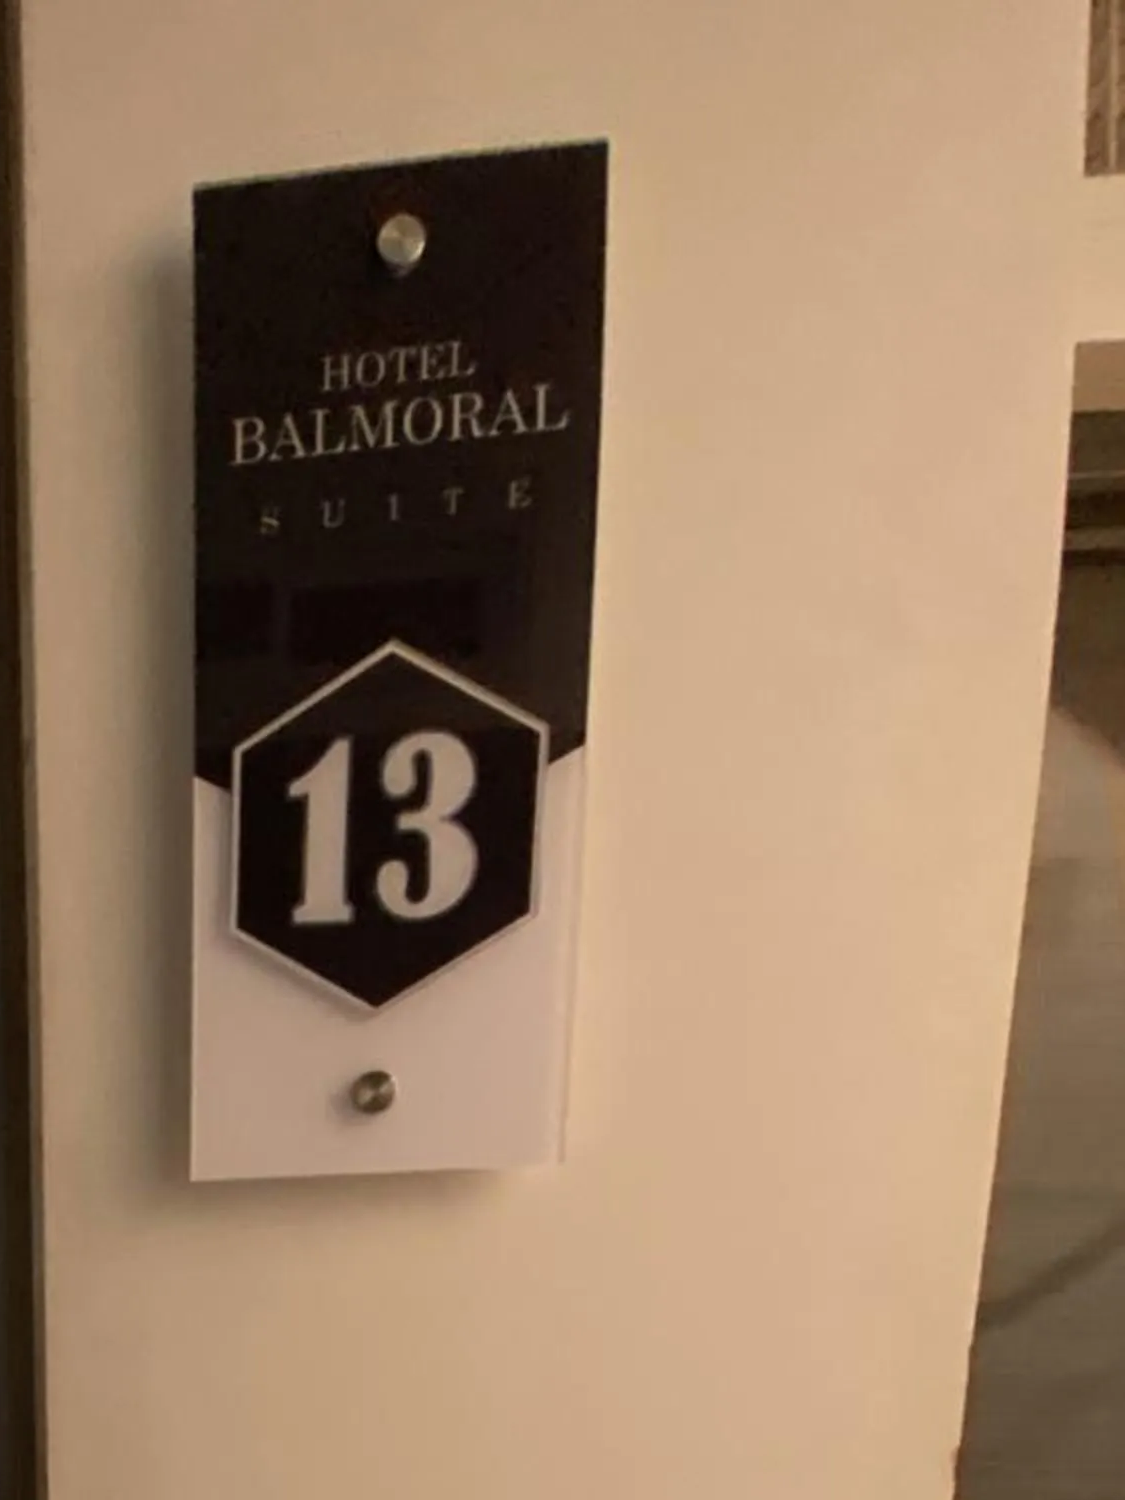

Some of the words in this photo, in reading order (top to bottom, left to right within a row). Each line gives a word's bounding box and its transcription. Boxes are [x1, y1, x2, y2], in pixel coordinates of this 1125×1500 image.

[321, 340, 477, 391] HOTEL
[229, 383, 571, 465] BALMORAL
[260, 476, 534, 535] SUITE
[287, 730, 479, 925] 13
